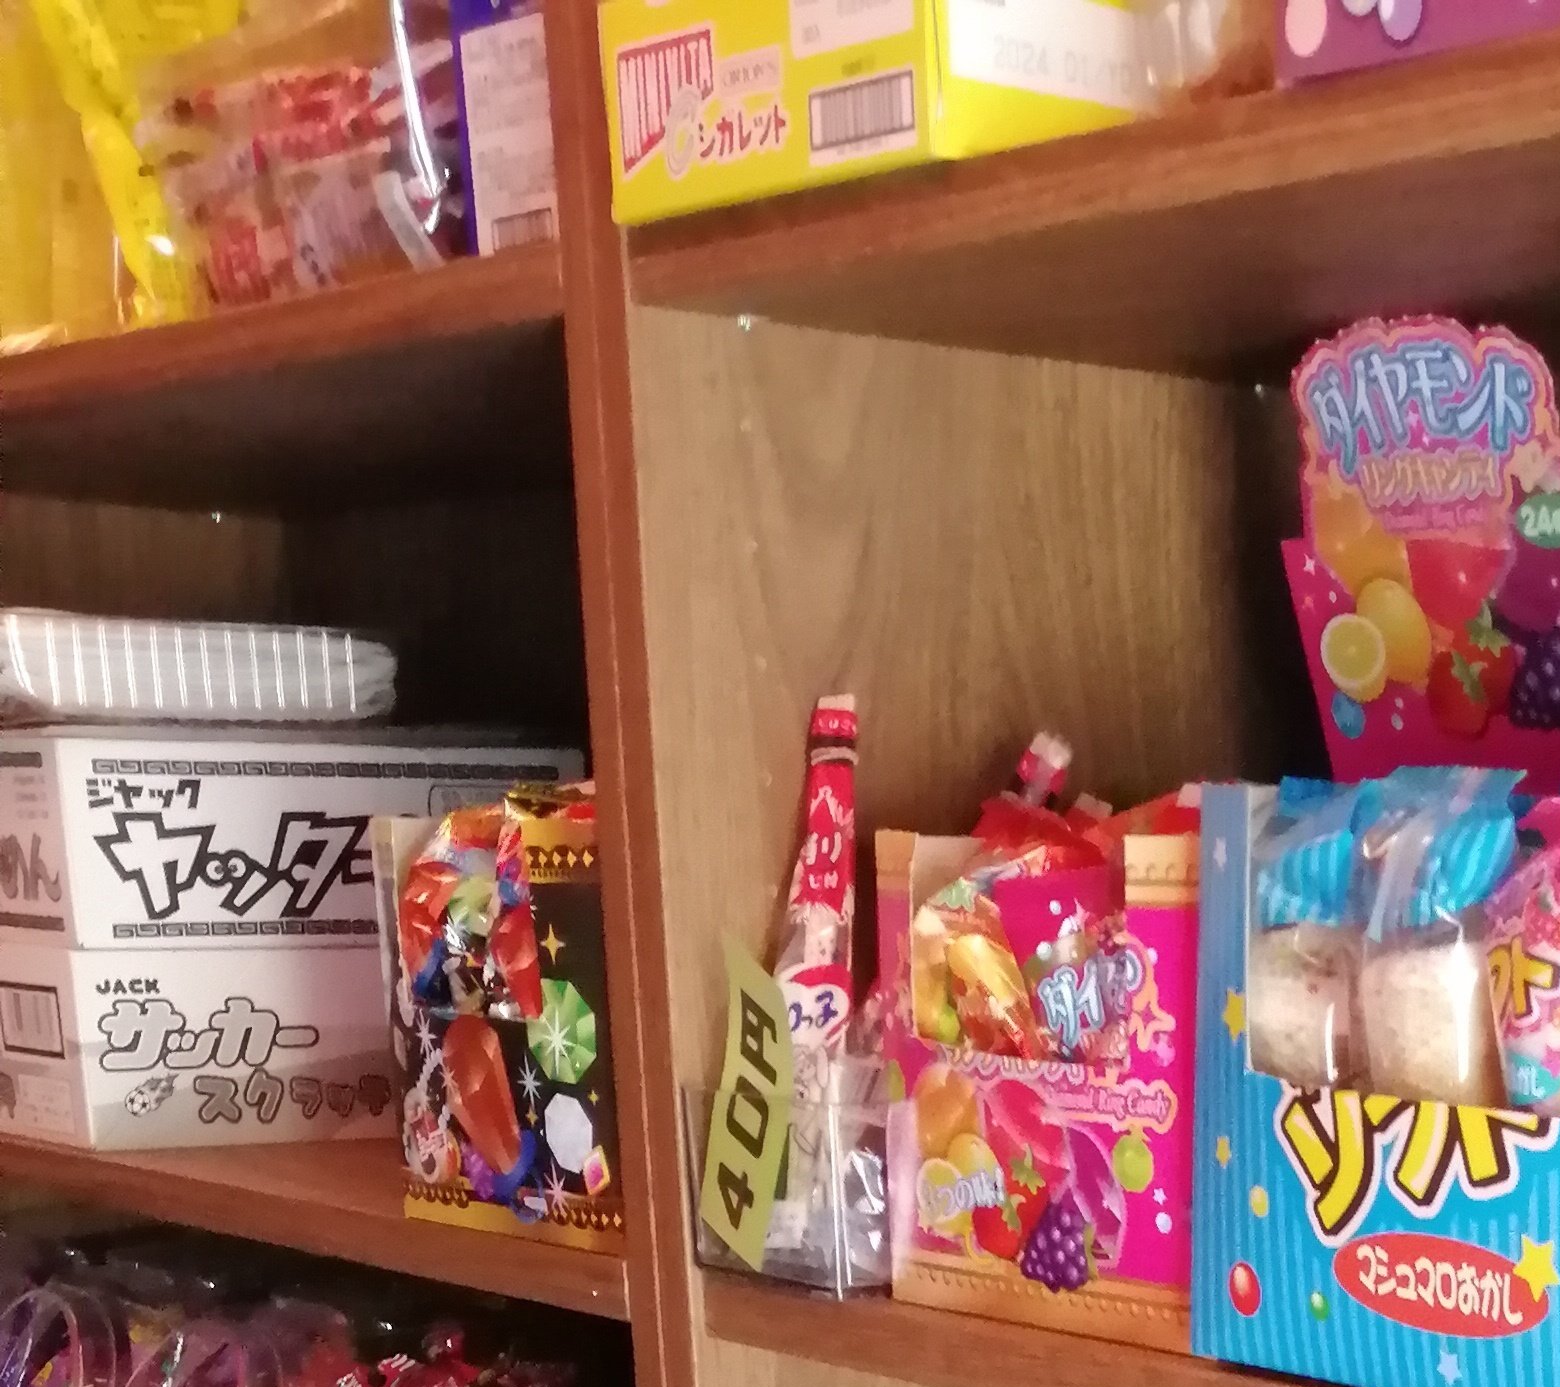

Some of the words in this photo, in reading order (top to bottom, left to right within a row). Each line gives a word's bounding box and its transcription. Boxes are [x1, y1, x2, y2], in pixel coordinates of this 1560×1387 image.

[700, 103, 787, 158] シガレット
[1312, 343, 1532, 472] ダイヤモンド
[87, 779, 202, 810] ジャック
[96, 977, 160, 996] JACK
[101, 998, 318, 1071] サッカー
[717, 982, 780, 1230] 40円
[1357, 1243, 1523, 1327] マシュマロおかし
